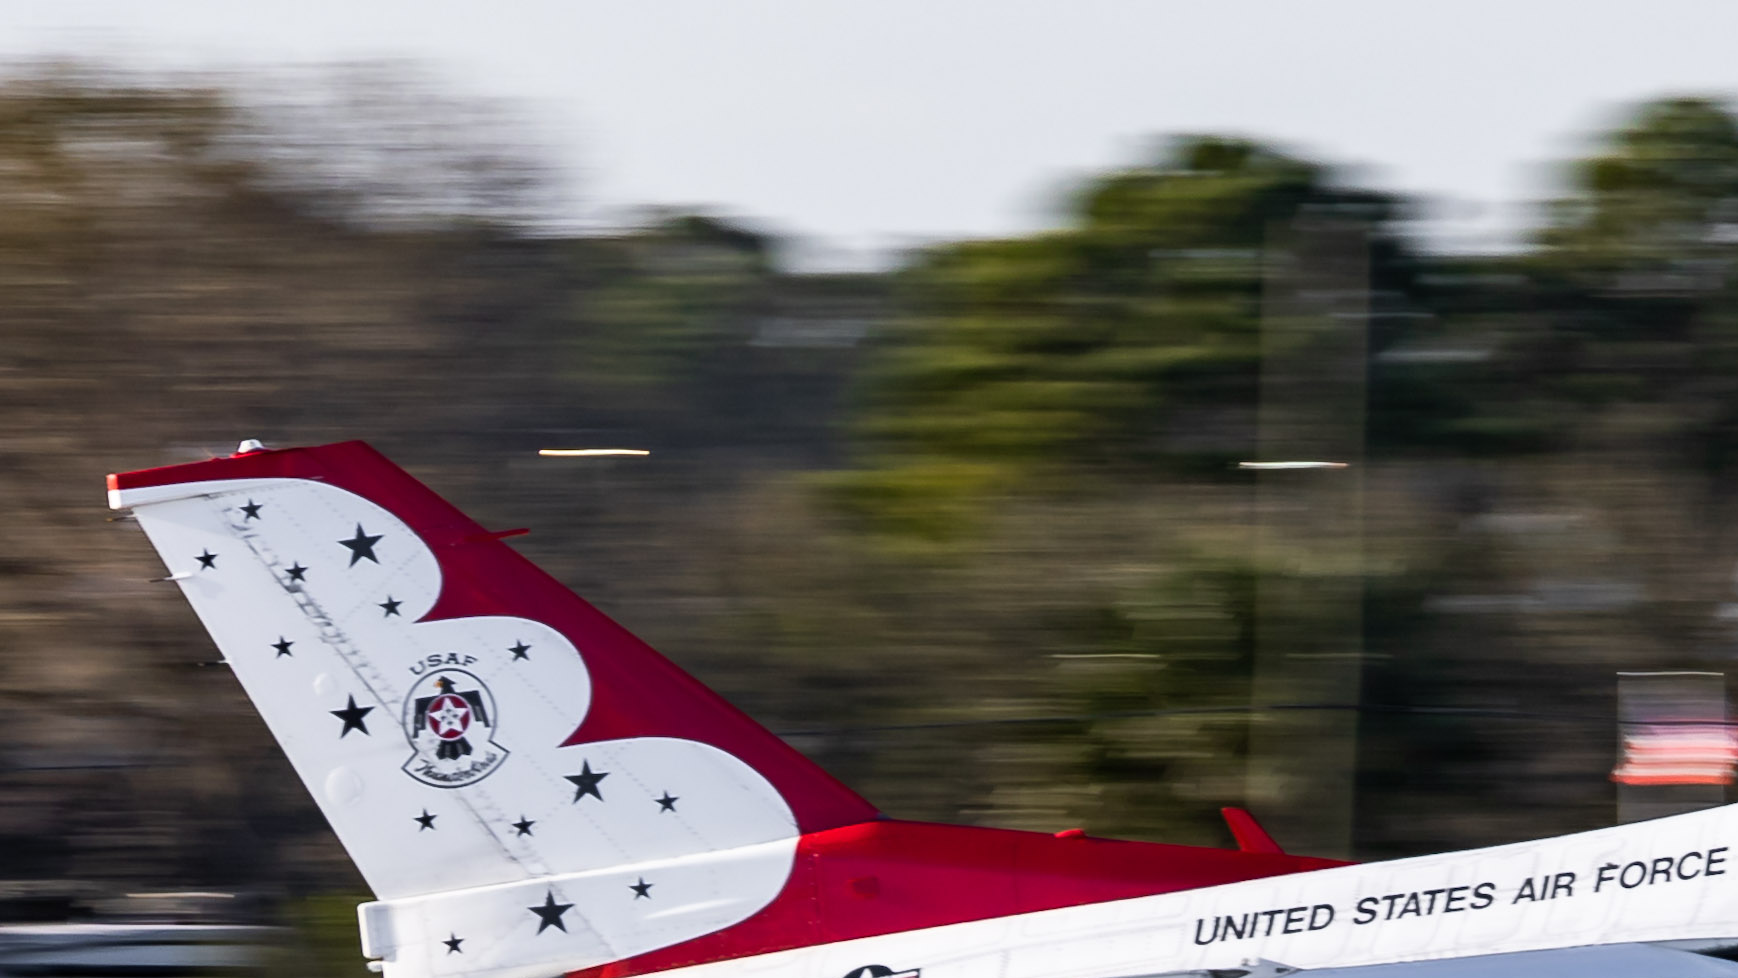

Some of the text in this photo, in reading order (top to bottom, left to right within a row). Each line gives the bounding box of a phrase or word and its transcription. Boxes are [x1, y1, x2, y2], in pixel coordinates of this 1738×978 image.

[409, 652, 478, 675] USAF
[1194, 846, 1729, 945] UNITED STATES AIR FORCE
